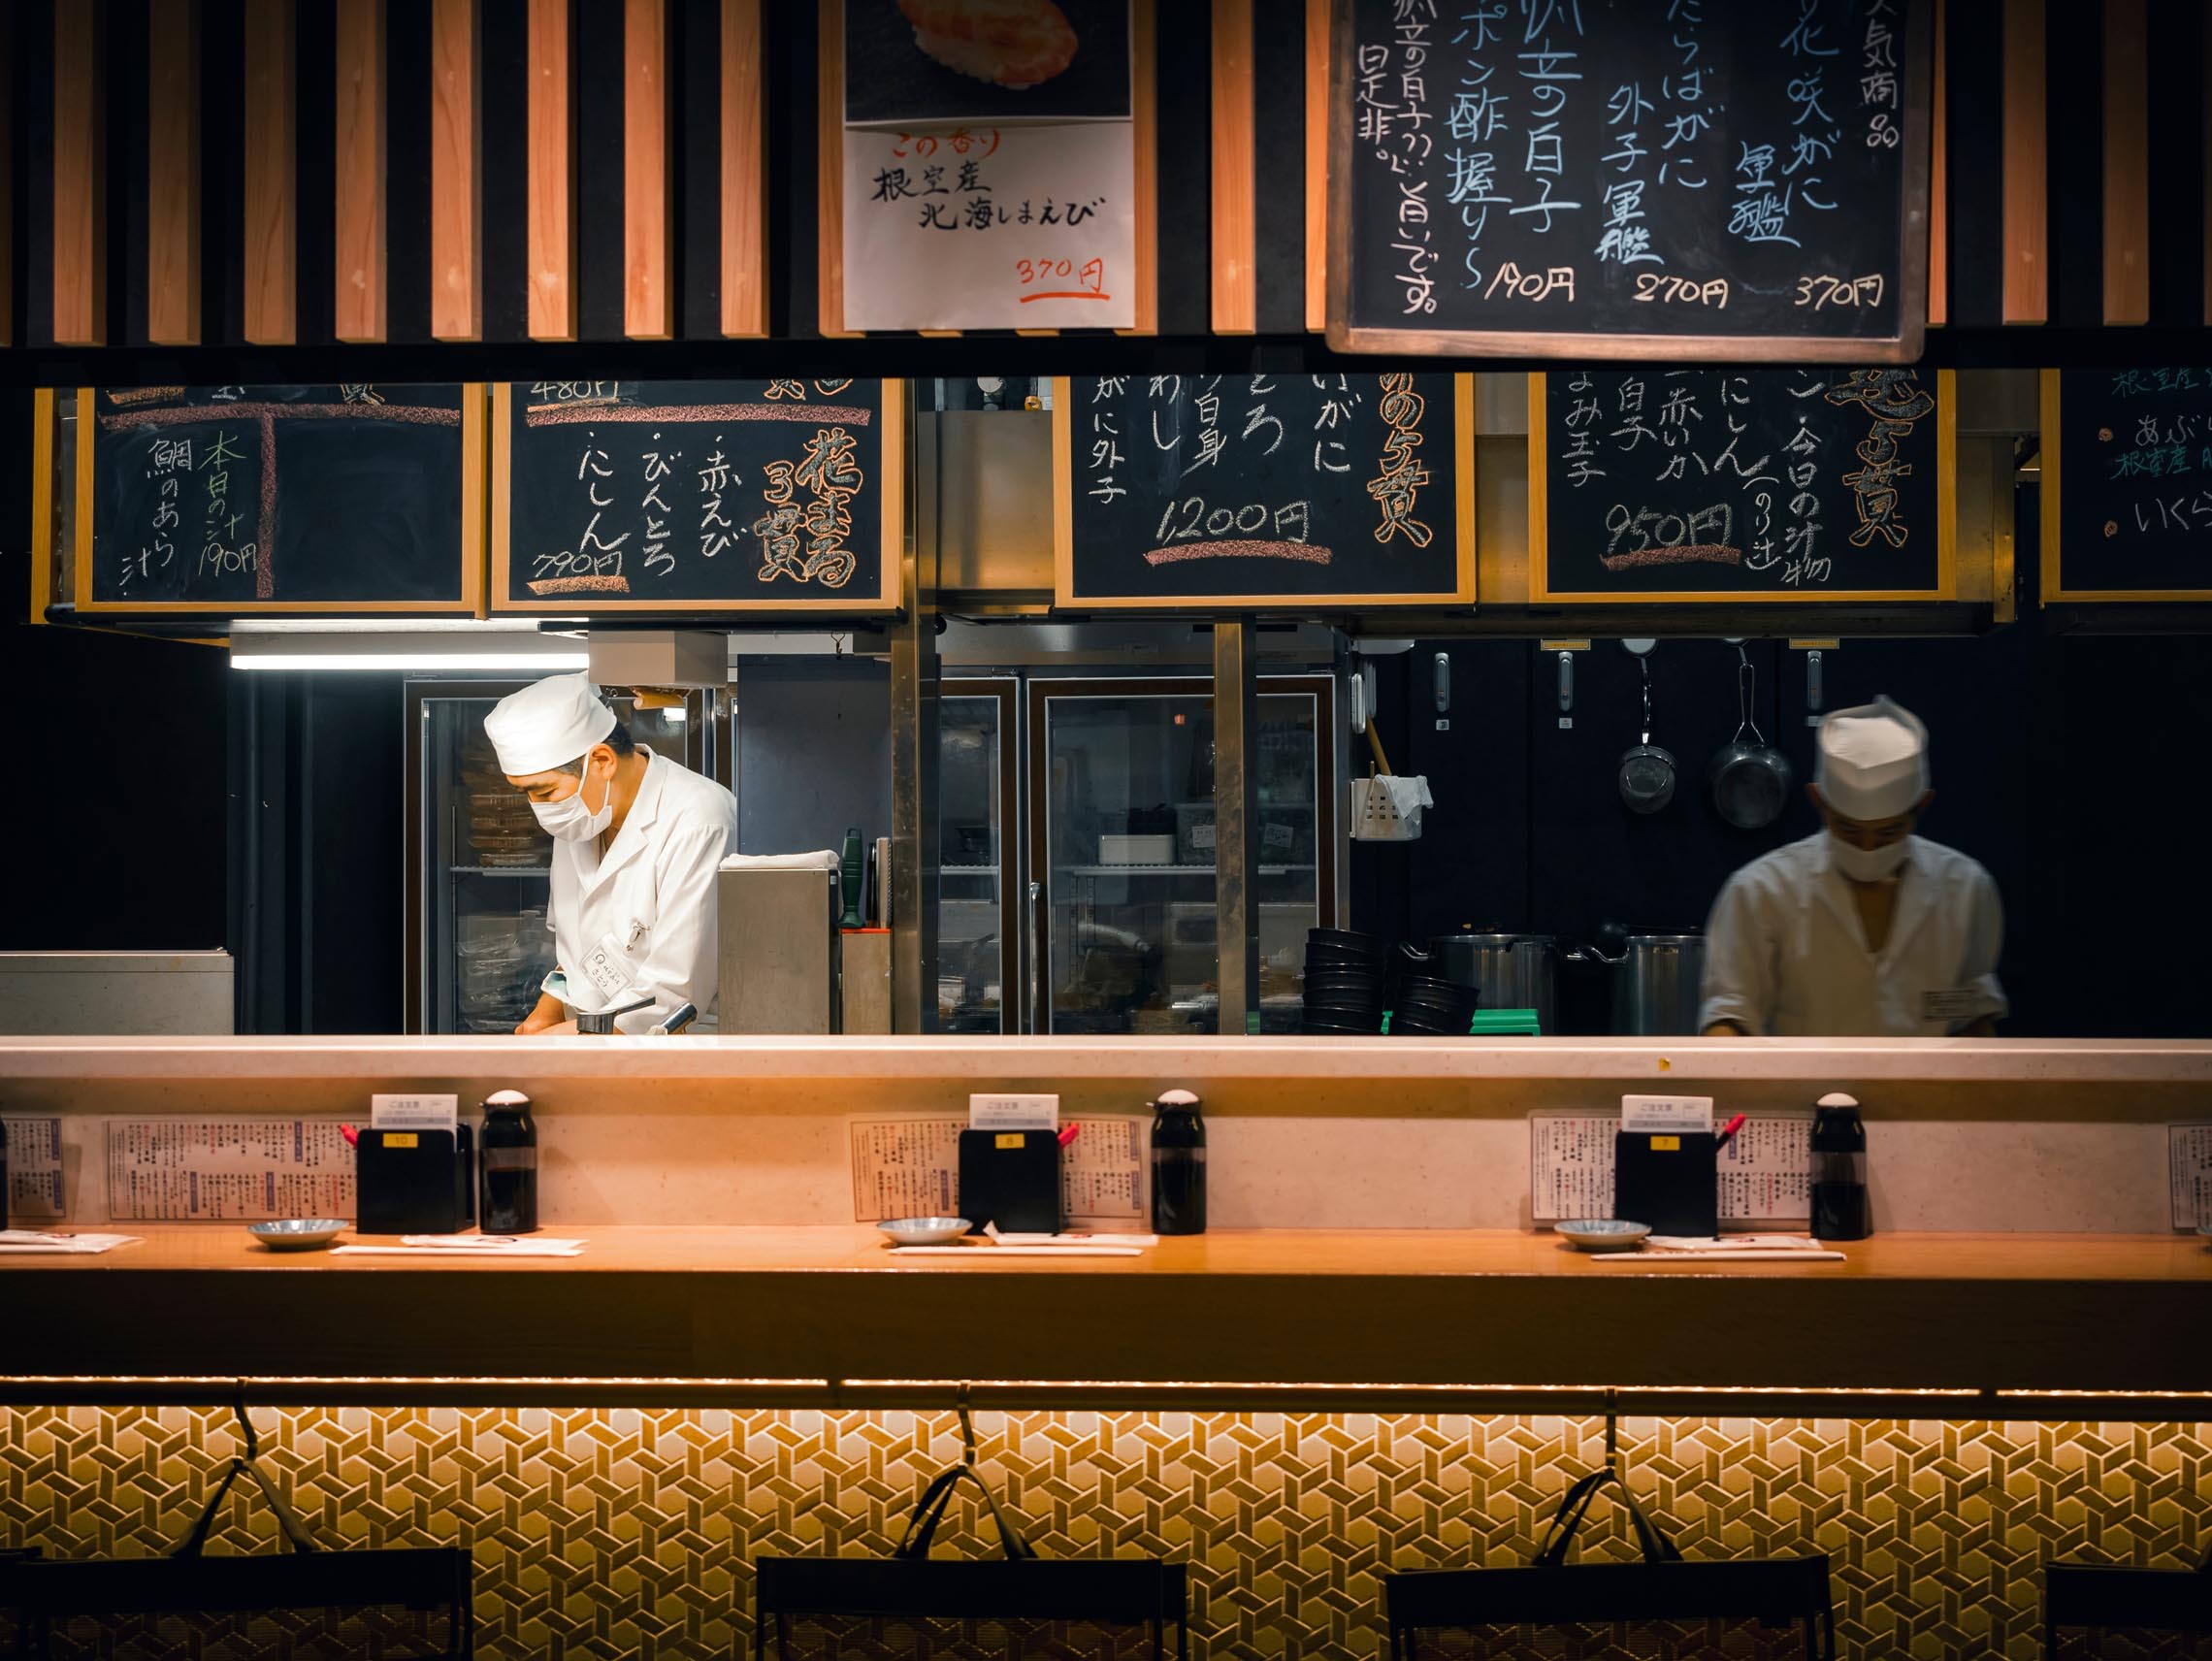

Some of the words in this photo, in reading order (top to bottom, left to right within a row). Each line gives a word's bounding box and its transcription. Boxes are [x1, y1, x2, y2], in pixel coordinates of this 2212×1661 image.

[892, 127, 1001, 159] この香り
[918, 196, 1107, 230] 北海しまえび
[1016, 257, 1104, 294] 370円
[1483, 264, 1576, 303] 190円
[1634, 274, 1730, 309] 270円
[1795, 274, 1884, 310] 370円
[1713, 376, 1772, 478] にしん
[197, 430, 247, 540] 本日の汁
[578, 448, 633, 552] にしん
[698, 450, 748, 558] 赤えび
[641, 451, 683, 577] びんとろ
[794, 427, 863, 589] 花まる
[1155, 496, 1311, 545] 1,200円
[1605, 502, 1735, 555] 950円
[198, 542, 258, 577] 190円
[531, 549, 624, 579] 790円
